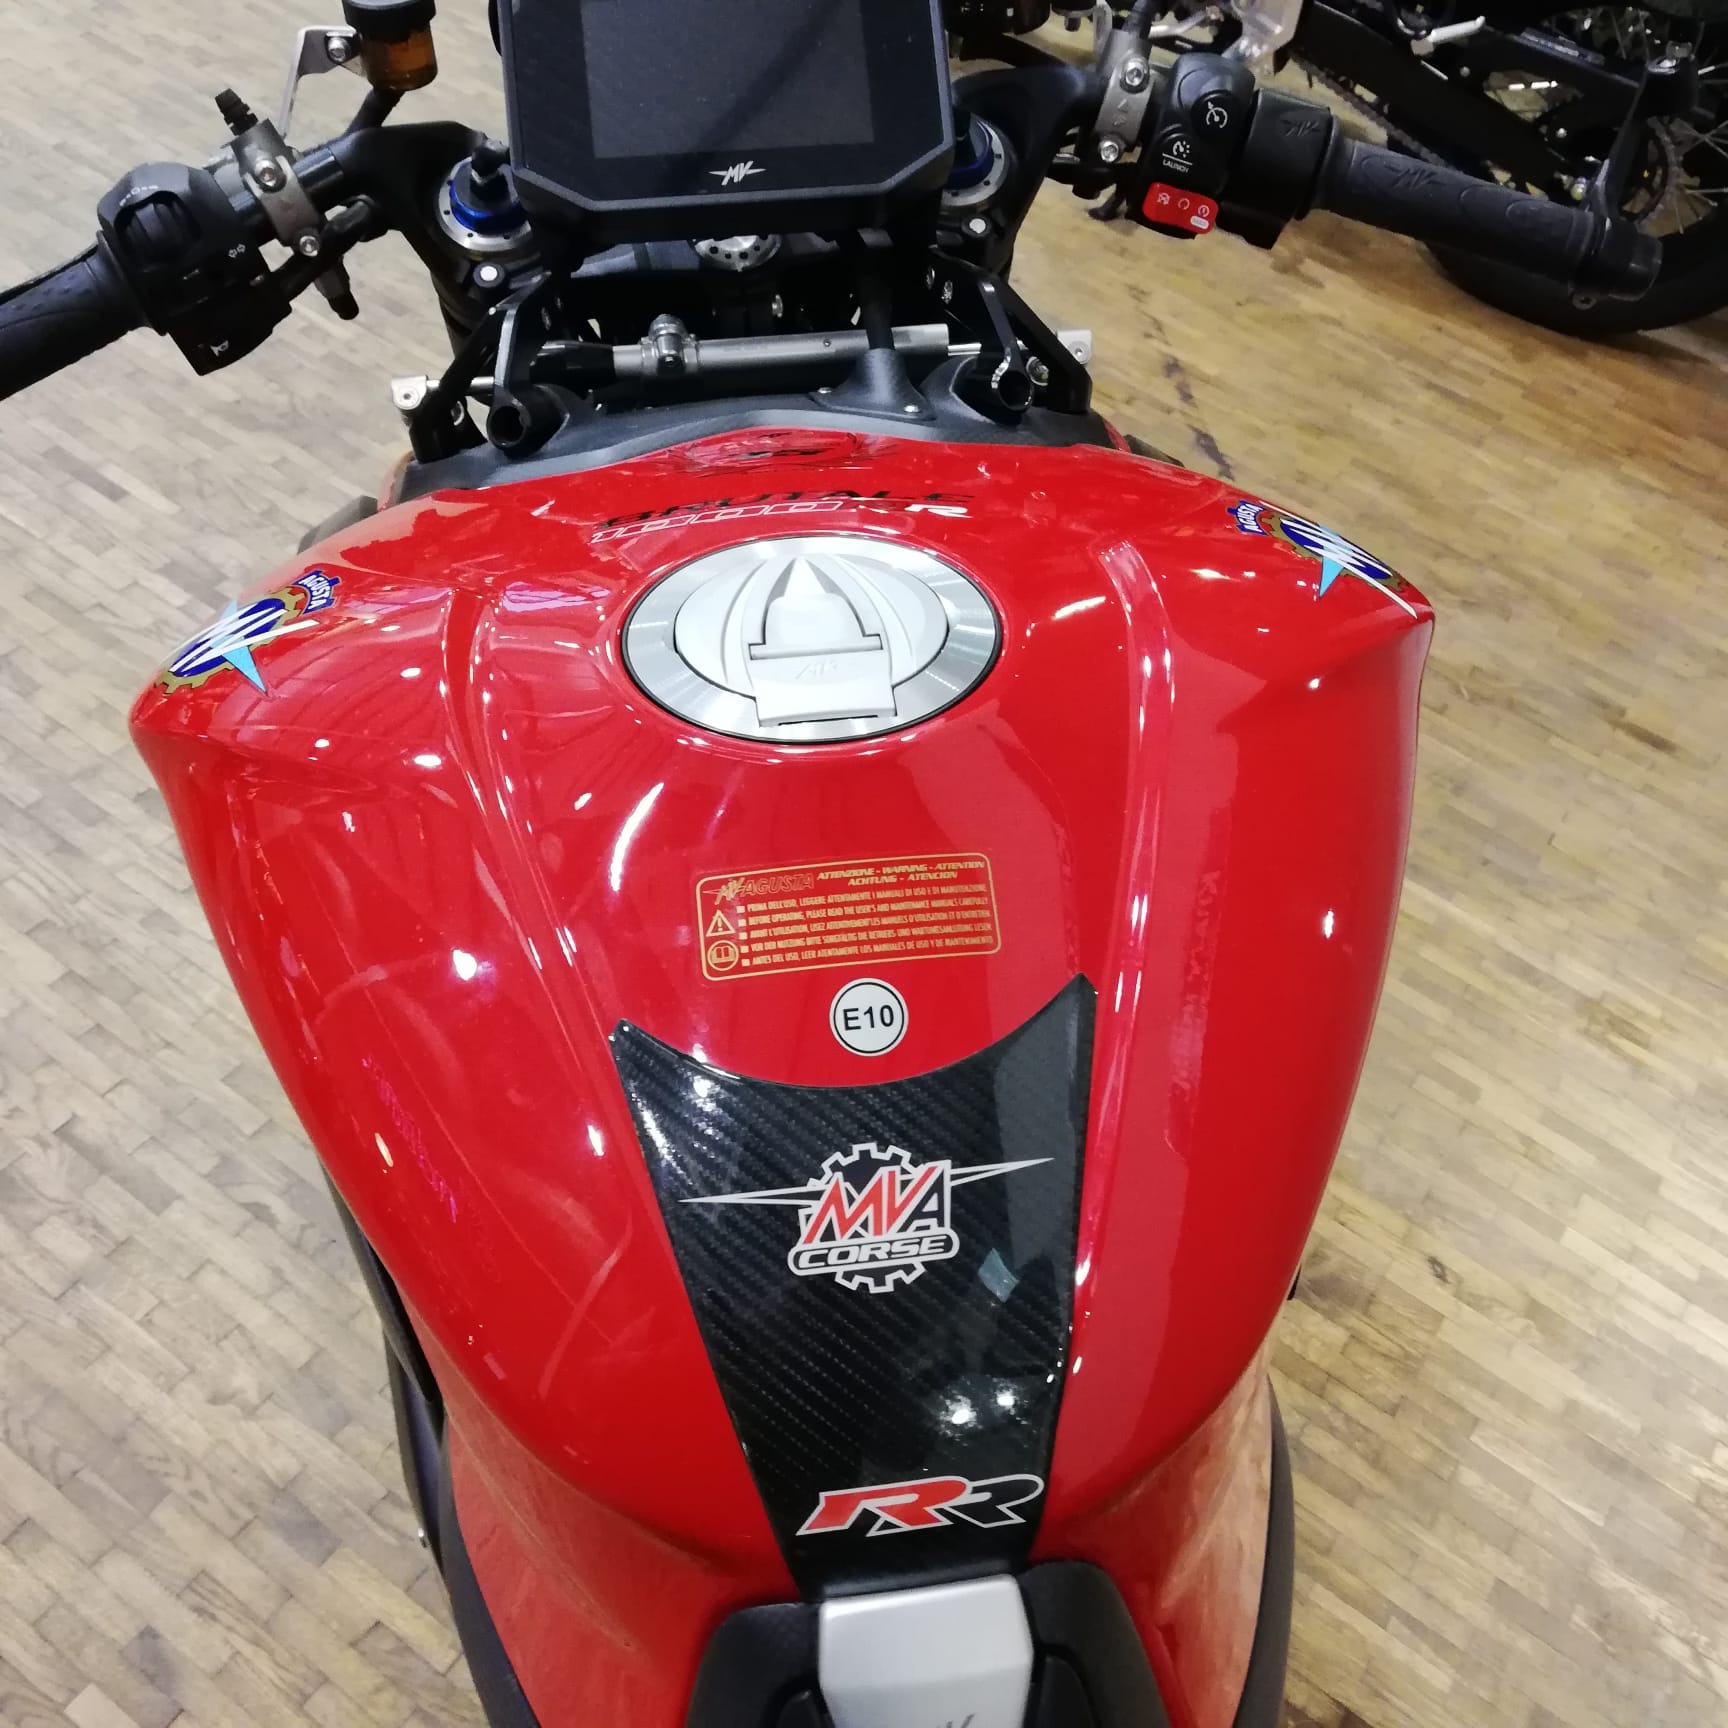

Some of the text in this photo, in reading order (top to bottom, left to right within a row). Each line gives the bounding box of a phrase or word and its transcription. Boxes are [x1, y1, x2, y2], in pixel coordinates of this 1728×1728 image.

[1236, 502, 1264, 533] AGUSTA
[297, 574, 332, 610] AGUSTA
[882, 864, 928, 875] WARNING
[934, 861, 985, 872] ATTENTION
[740, 874, 814, 897] AGUSTA
[843, 1004, 895, 1031] E10
[796, 1235, 948, 1269] CORSE
